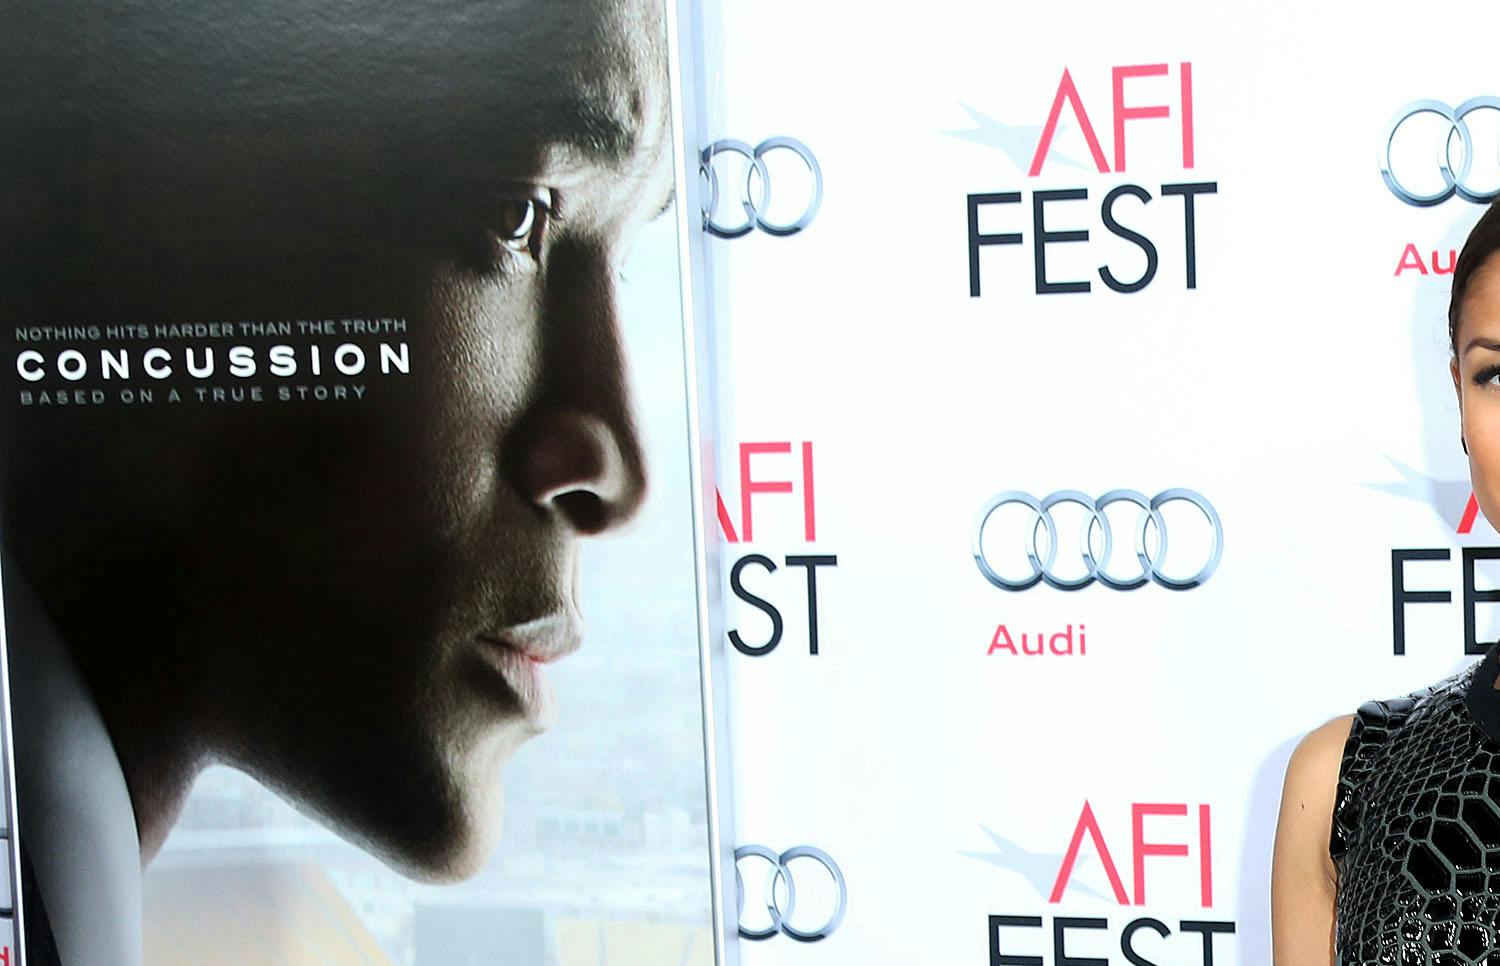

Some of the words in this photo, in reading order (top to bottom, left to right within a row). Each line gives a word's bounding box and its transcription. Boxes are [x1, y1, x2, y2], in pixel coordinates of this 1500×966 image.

[1029, 61, 1195, 176] AFI
[966, 181, 1218, 298] FEST
[1394, 243, 1456, 277] Au
[15, 325, 101, 342] NOTHING
[106, 323, 149, 340] HITS
[154, 322, 234, 339] HARDER
[239, 321, 292, 337] THAN
[297, 320, 335, 336] THE
[340, 318, 408, 335] TRUTH
[15, 342, 411, 382] CONCUSSION
[20, 389, 105, 406] BASED
[120, 388, 154, 404] ON
[168, 387, 182, 403] A
[195, 386, 263, 402] TRUE
[278, 384, 367, 401] STORY
[715, 440, 817, 543] FI
[727, 553, 838, 657] ST
[987, 623, 1086, 656] Audi
[1048, 799, 1213, 908] AFI
